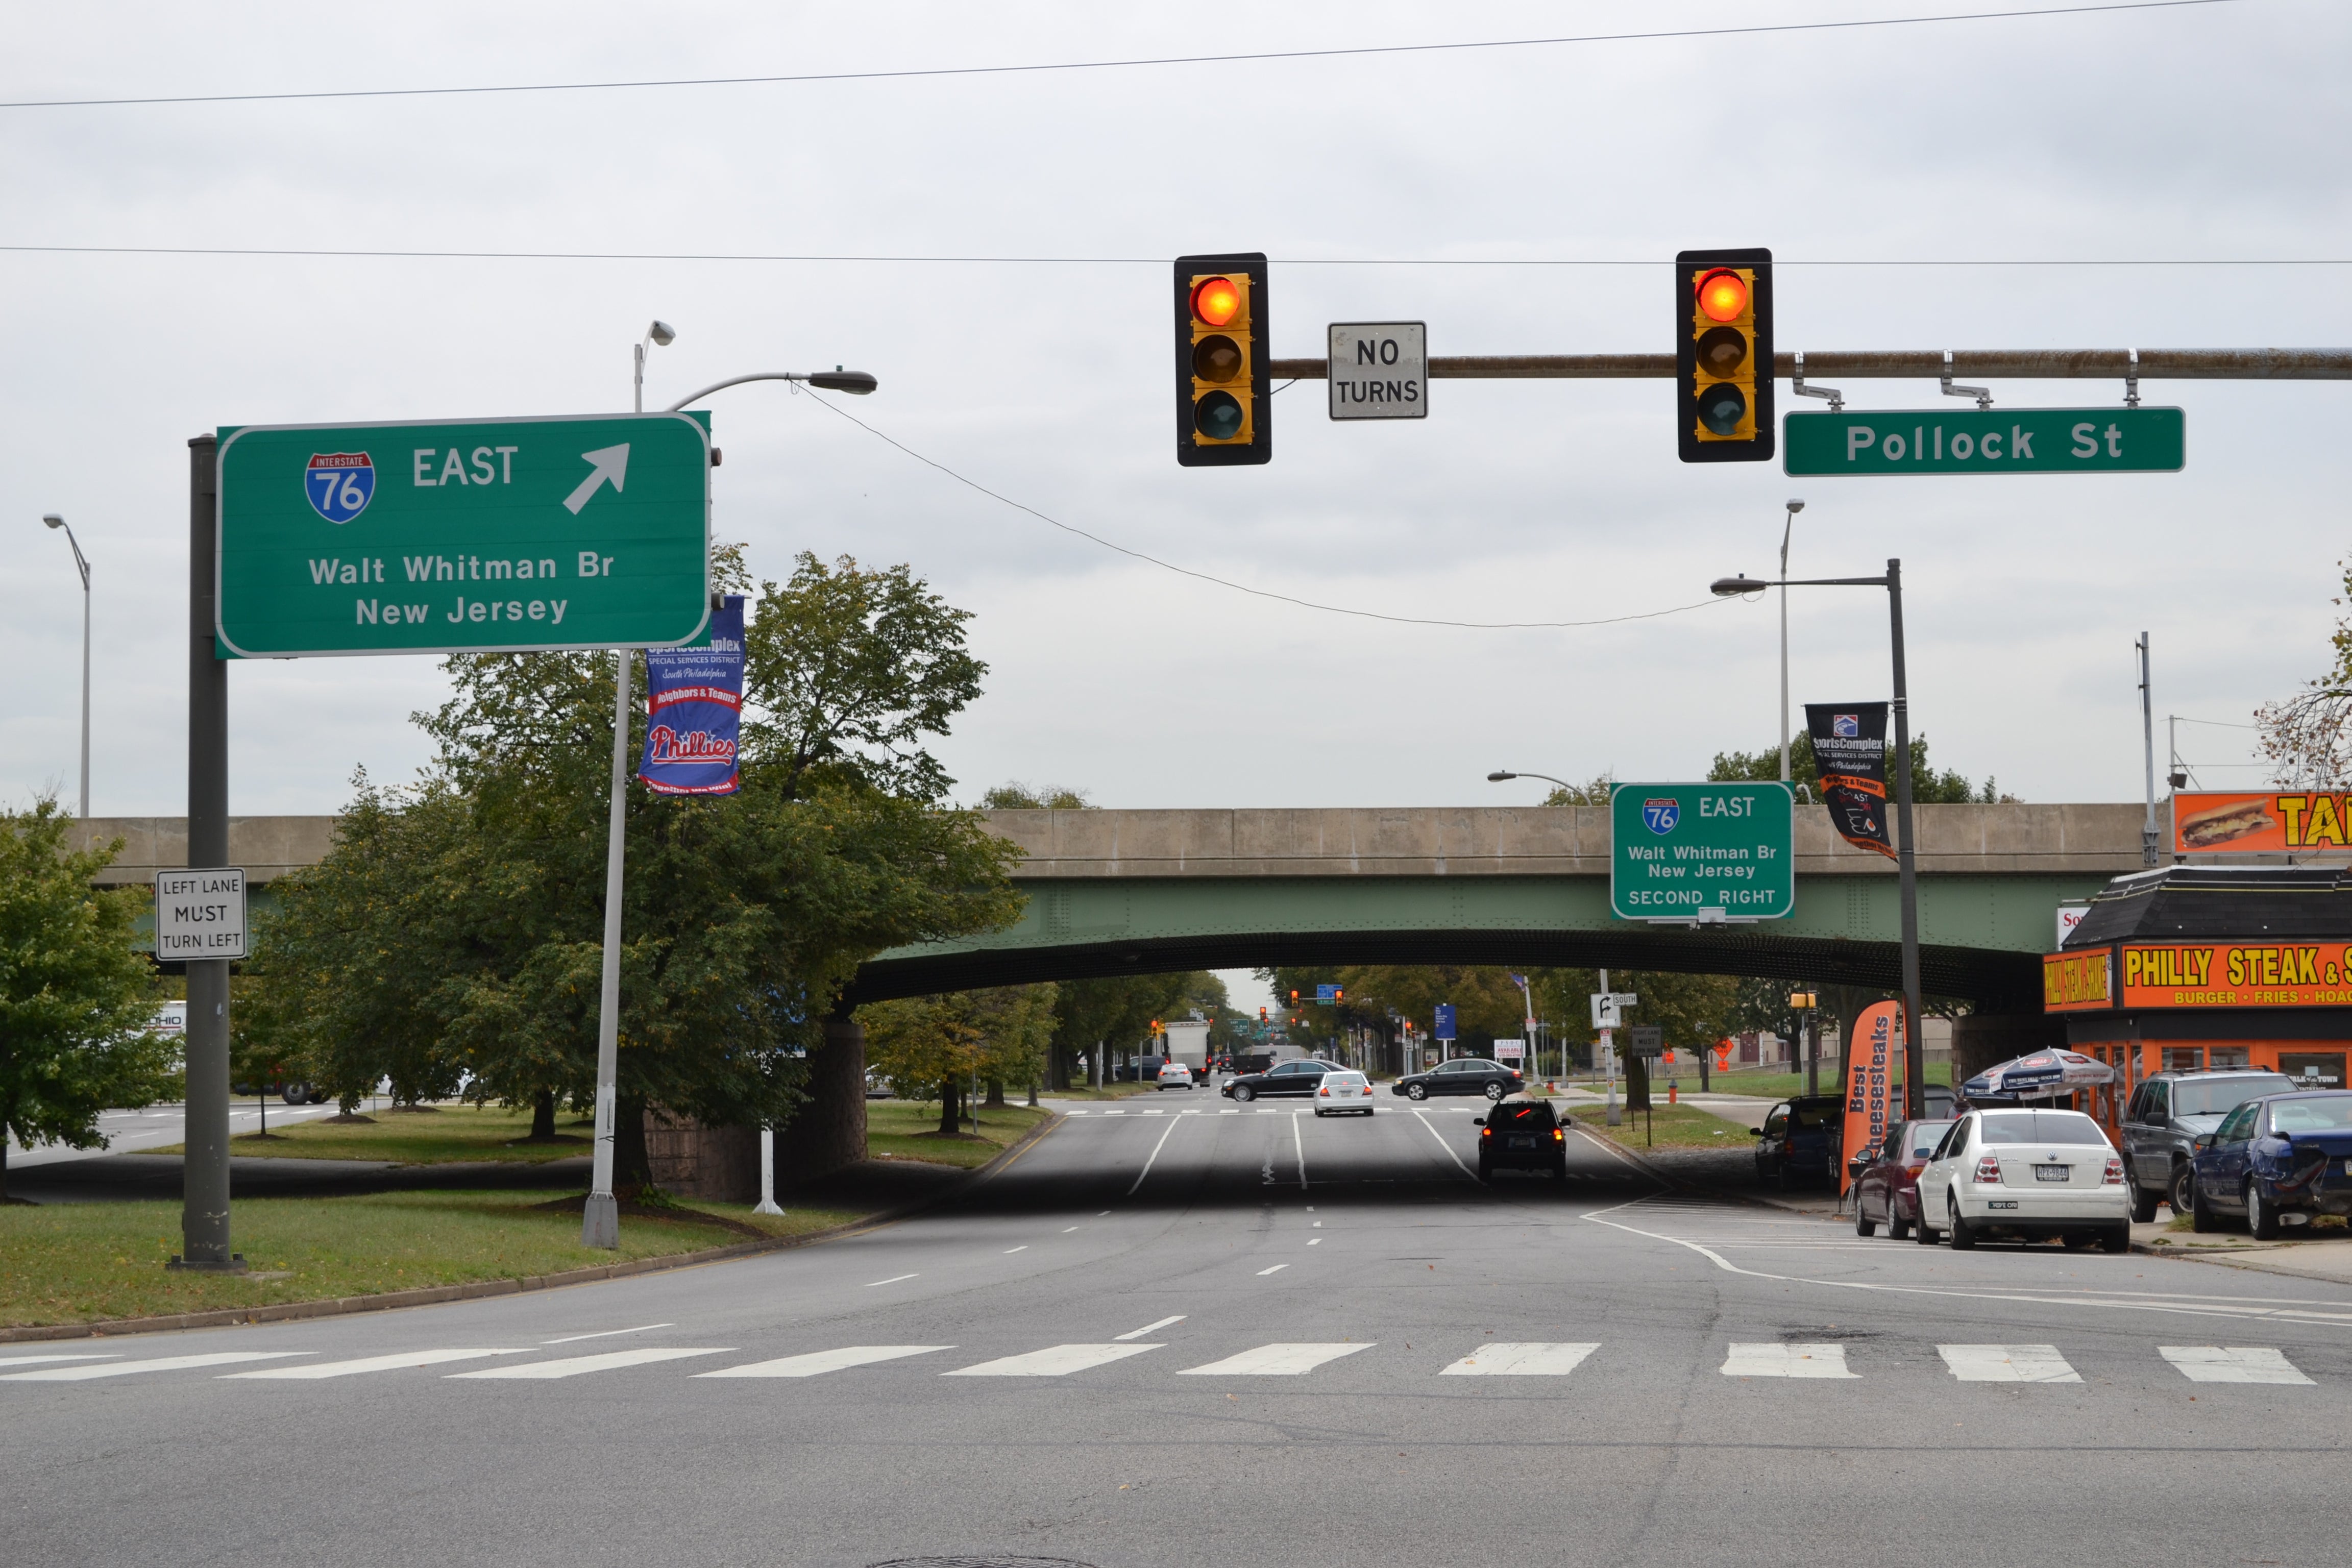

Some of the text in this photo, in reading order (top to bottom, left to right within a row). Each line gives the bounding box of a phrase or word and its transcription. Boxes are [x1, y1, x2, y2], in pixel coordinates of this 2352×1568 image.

[1358, 339, 1399, 365] NO
[1337, 380, 1418, 403] TURNS
[1848, 423, 2122, 461] Pollock St
[316, 457, 363, 467] INTERSTATE
[413, 446, 519, 486] EAST
[315, 472, 364, 510] 76
[309, 551, 614, 584] Walt Whitman Br
[356, 597, 568, 624] New Jersey
[663, 668, 726, 680] South Philadelphia
[657, 688, 737, 704] Neighbors & Teams
[650, 725, 736, 758] Phillies
[1836, 761, 1871, 772] Philadelphia
[1700, 797, 1755, 817] EAST
[1648, 808, 1674, 828] 76
[2277, 796, 2352, 846] TA
[1628, 845, 1776, 860] Walt Whitman Br
[1649, 864, 1755, 879] New Jersey
[164, 879, 239, 894] LEFT LANE
[1629, 890, 1775, 904] SECOND RIGHT
[175, 905, 227, 922] MUST
[2064, 913, 2085, 926] So
[163, 934, 240, 948] TURN LEFT
[2125, 949, 2214, 986] PHILLY
[2227, 947, 2319, 986] STEAK
[2324, 962, 2340, 986] &
[2045, 960, 2062, 1005] PHILLY
[2065, 957, 2082, 1004] STEAK
[2174, 992, 2237, 1004] BURGER
[2255, 991, 2298, 1003] FRIES
[1849, 1064, 1867, 1113] Best
[1865, 1015, 1889, 1154] heesesteaks
